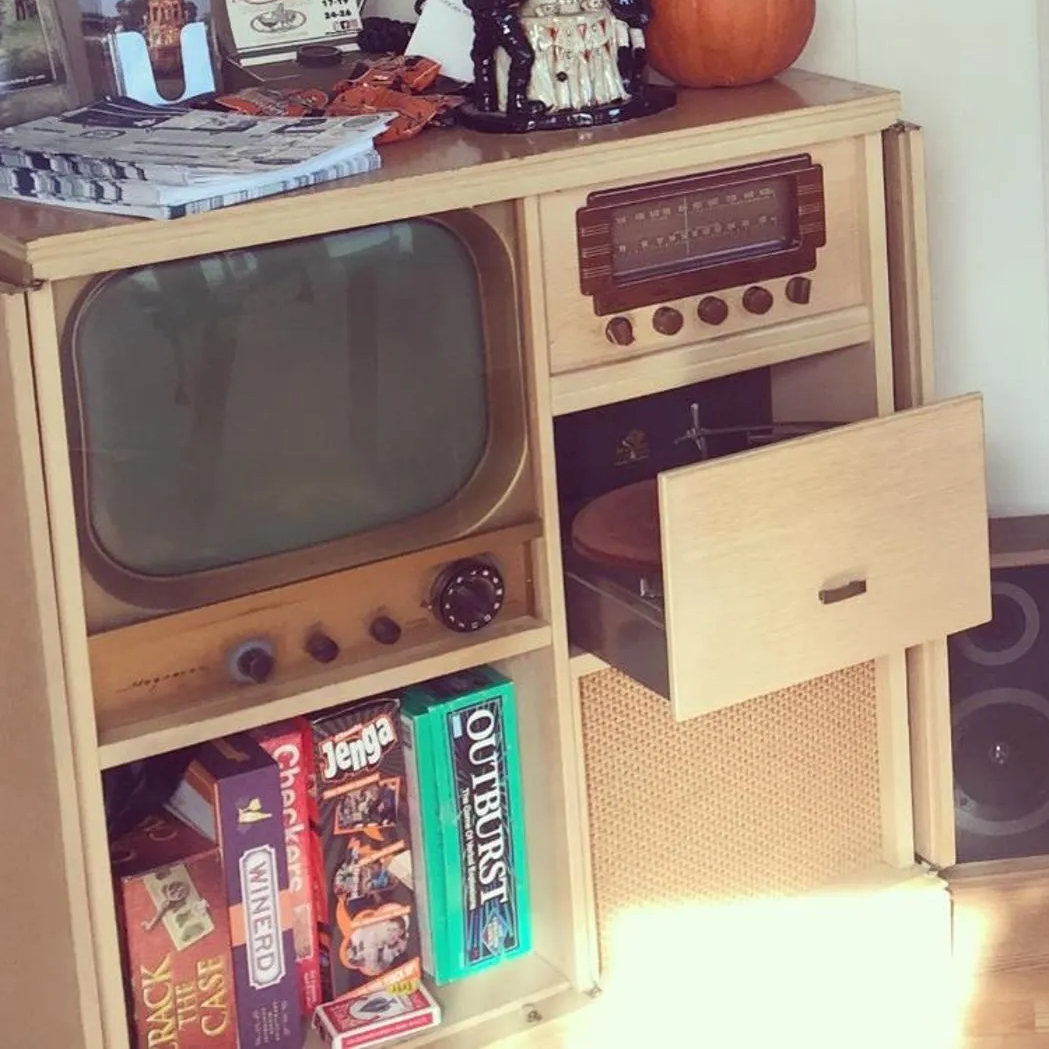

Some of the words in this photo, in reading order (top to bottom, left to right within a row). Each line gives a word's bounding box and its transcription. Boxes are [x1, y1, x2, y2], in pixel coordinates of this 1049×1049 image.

[321, 716, 397, 779] Jenga
[272, 743, 305, 893] Checkers
[462, 787, 470, 804] The
[467, 709, 509, 905] OUTBURST
[249, 860, 275, 973] WINERD
[175, 982, 198, 1031] THE
[196, 955, 229, 1037] CASE
